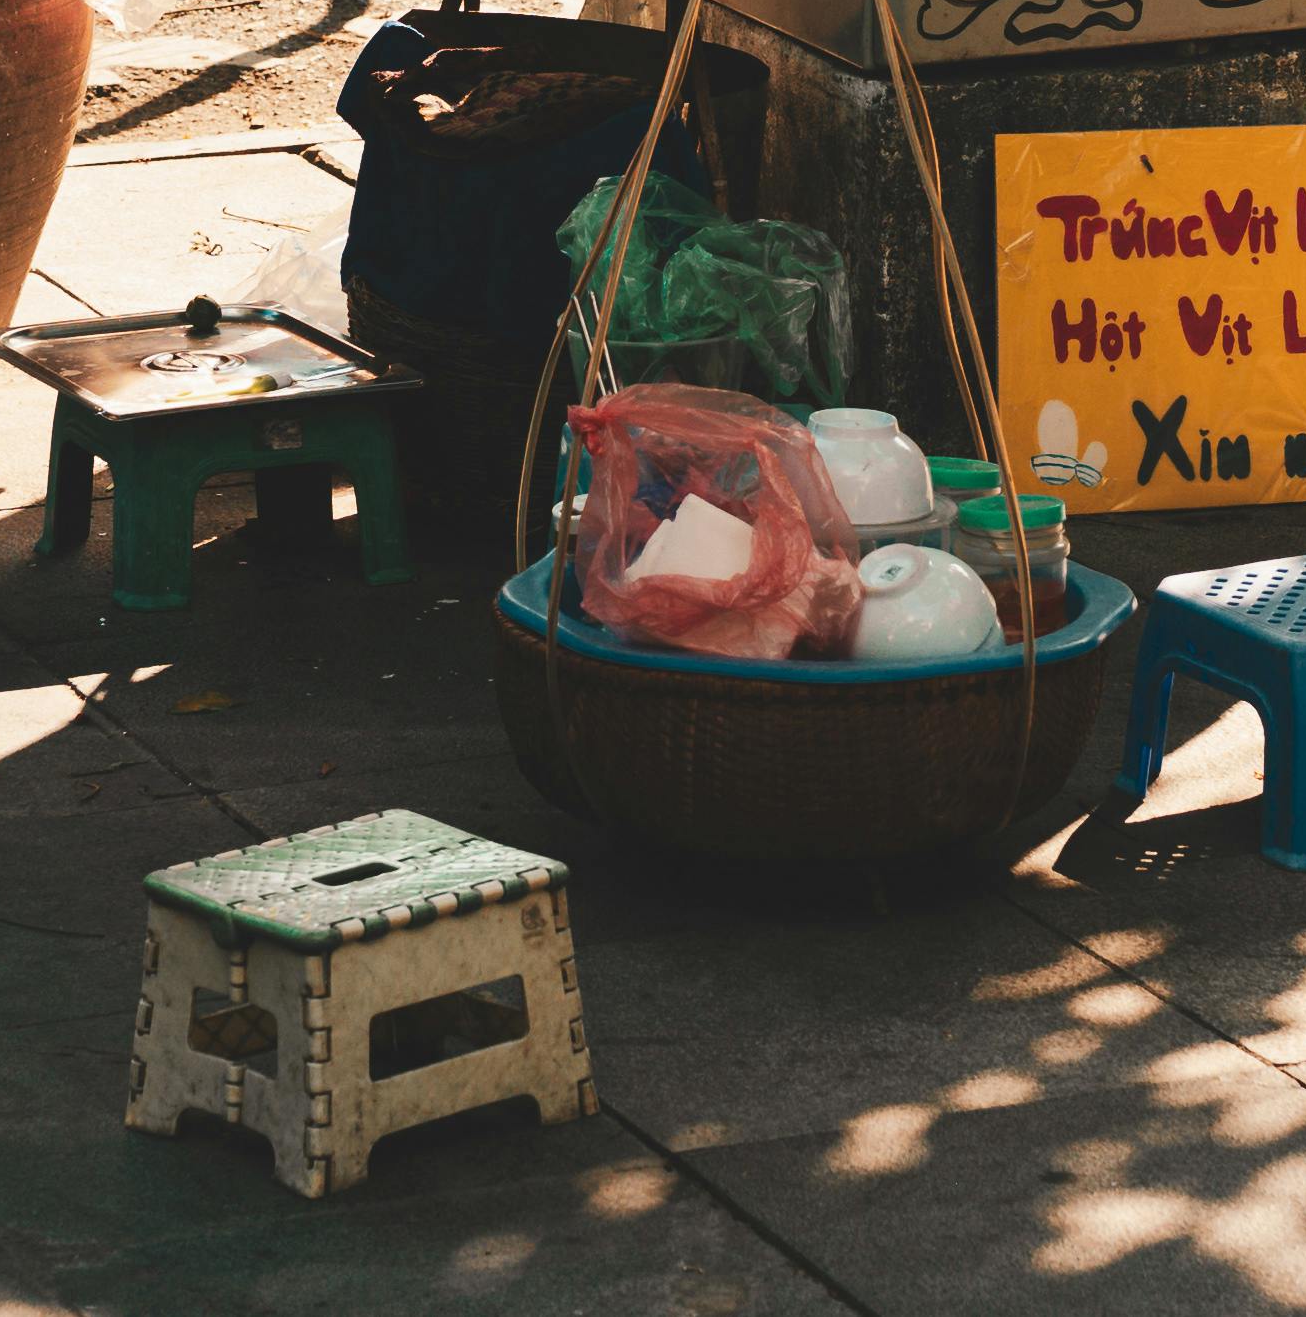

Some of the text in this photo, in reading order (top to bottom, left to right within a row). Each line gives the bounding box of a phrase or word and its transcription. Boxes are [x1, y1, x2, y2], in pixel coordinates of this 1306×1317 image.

[1205, 188, 1279, 265] Vịt
[1051, 297, 1146, 373] Hột
[1178, 293, 1253, 365] Vịt
[1131, 394, 1252, 486] Xin
